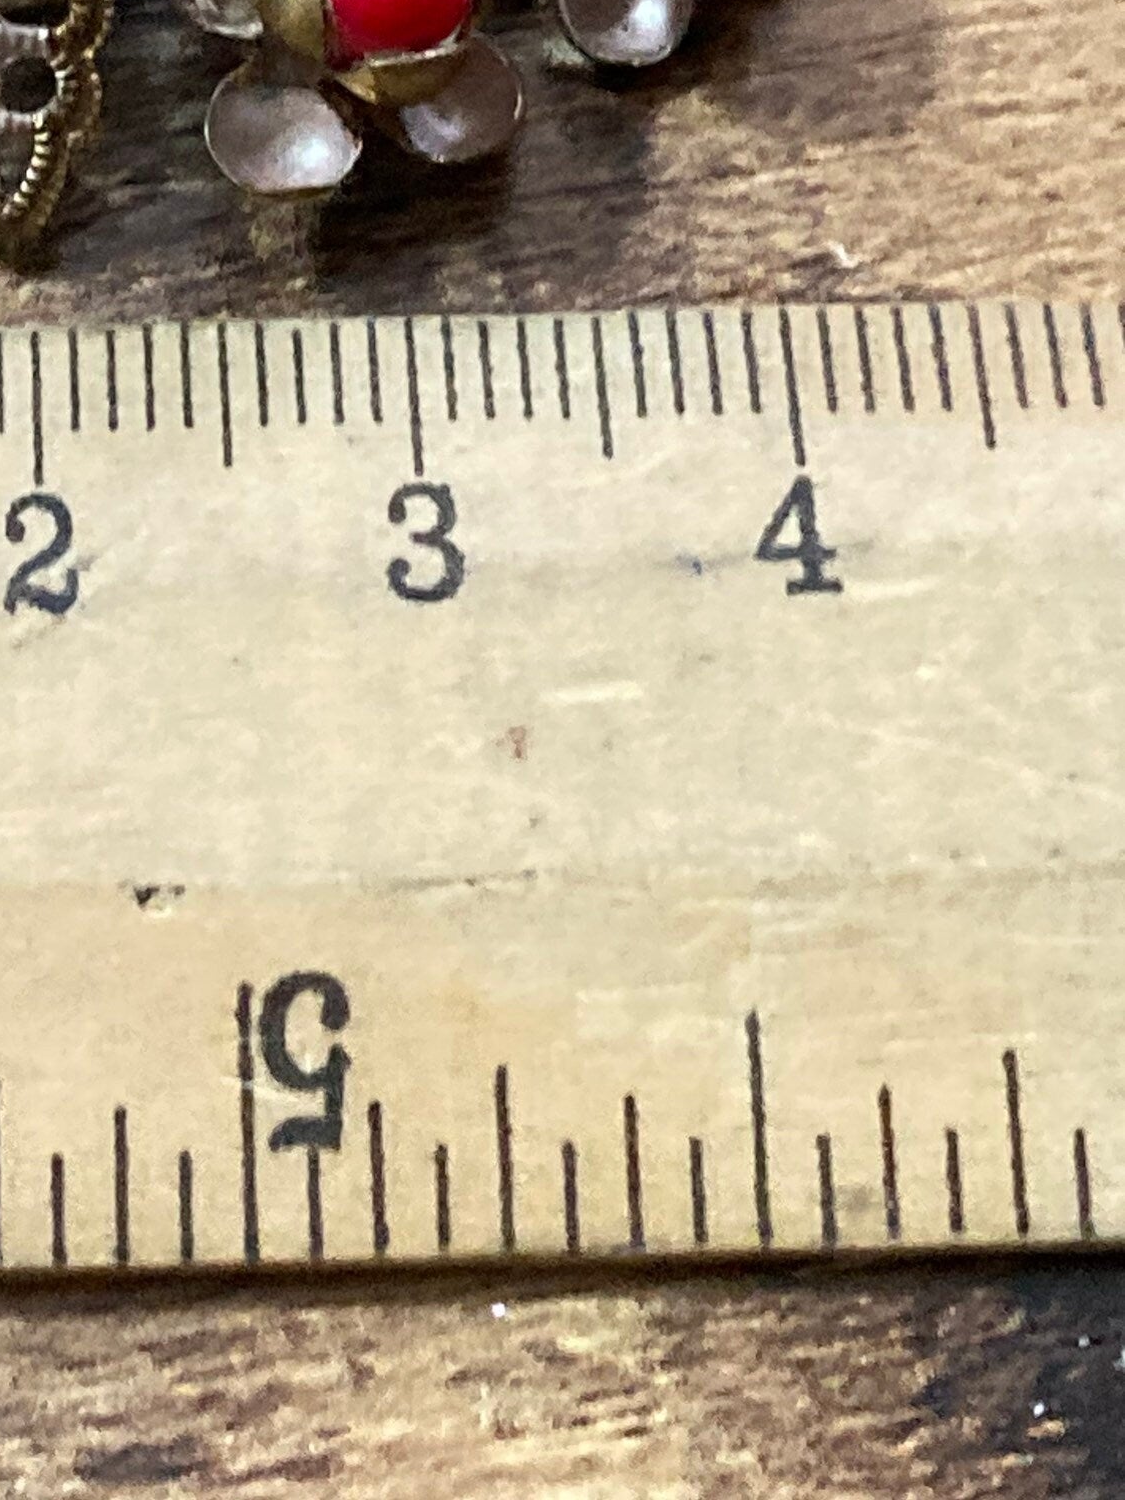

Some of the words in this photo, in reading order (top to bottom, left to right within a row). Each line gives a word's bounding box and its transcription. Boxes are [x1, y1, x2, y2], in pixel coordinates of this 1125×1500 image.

[4, 493, 81, 616] 2
[387, 483, 466, 603] 3
[755, 476, 843, 596] 4
[258, 970, 352, 1153] 5
